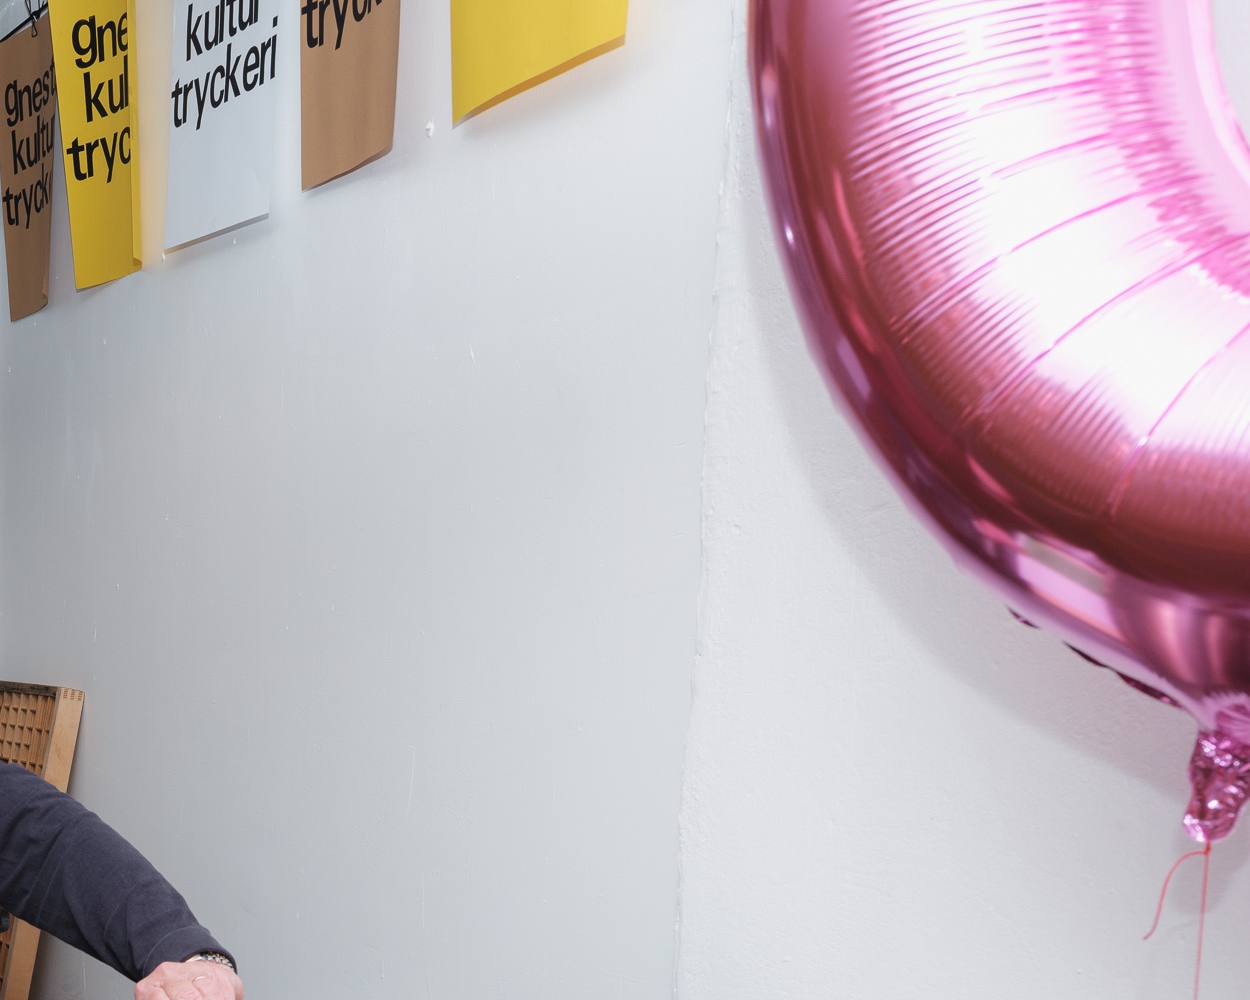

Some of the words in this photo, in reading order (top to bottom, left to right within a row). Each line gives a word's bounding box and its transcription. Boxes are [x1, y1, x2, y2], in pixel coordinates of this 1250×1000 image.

[72, 12, 128, 69] gne
[301, 0, 382, 50] try
[83, 54, 129, 123] kul
[171, 15, 279, 131] tryckeri
[66, 126, 131, 184] tryc
[3, 163, 52, 229] tryck
